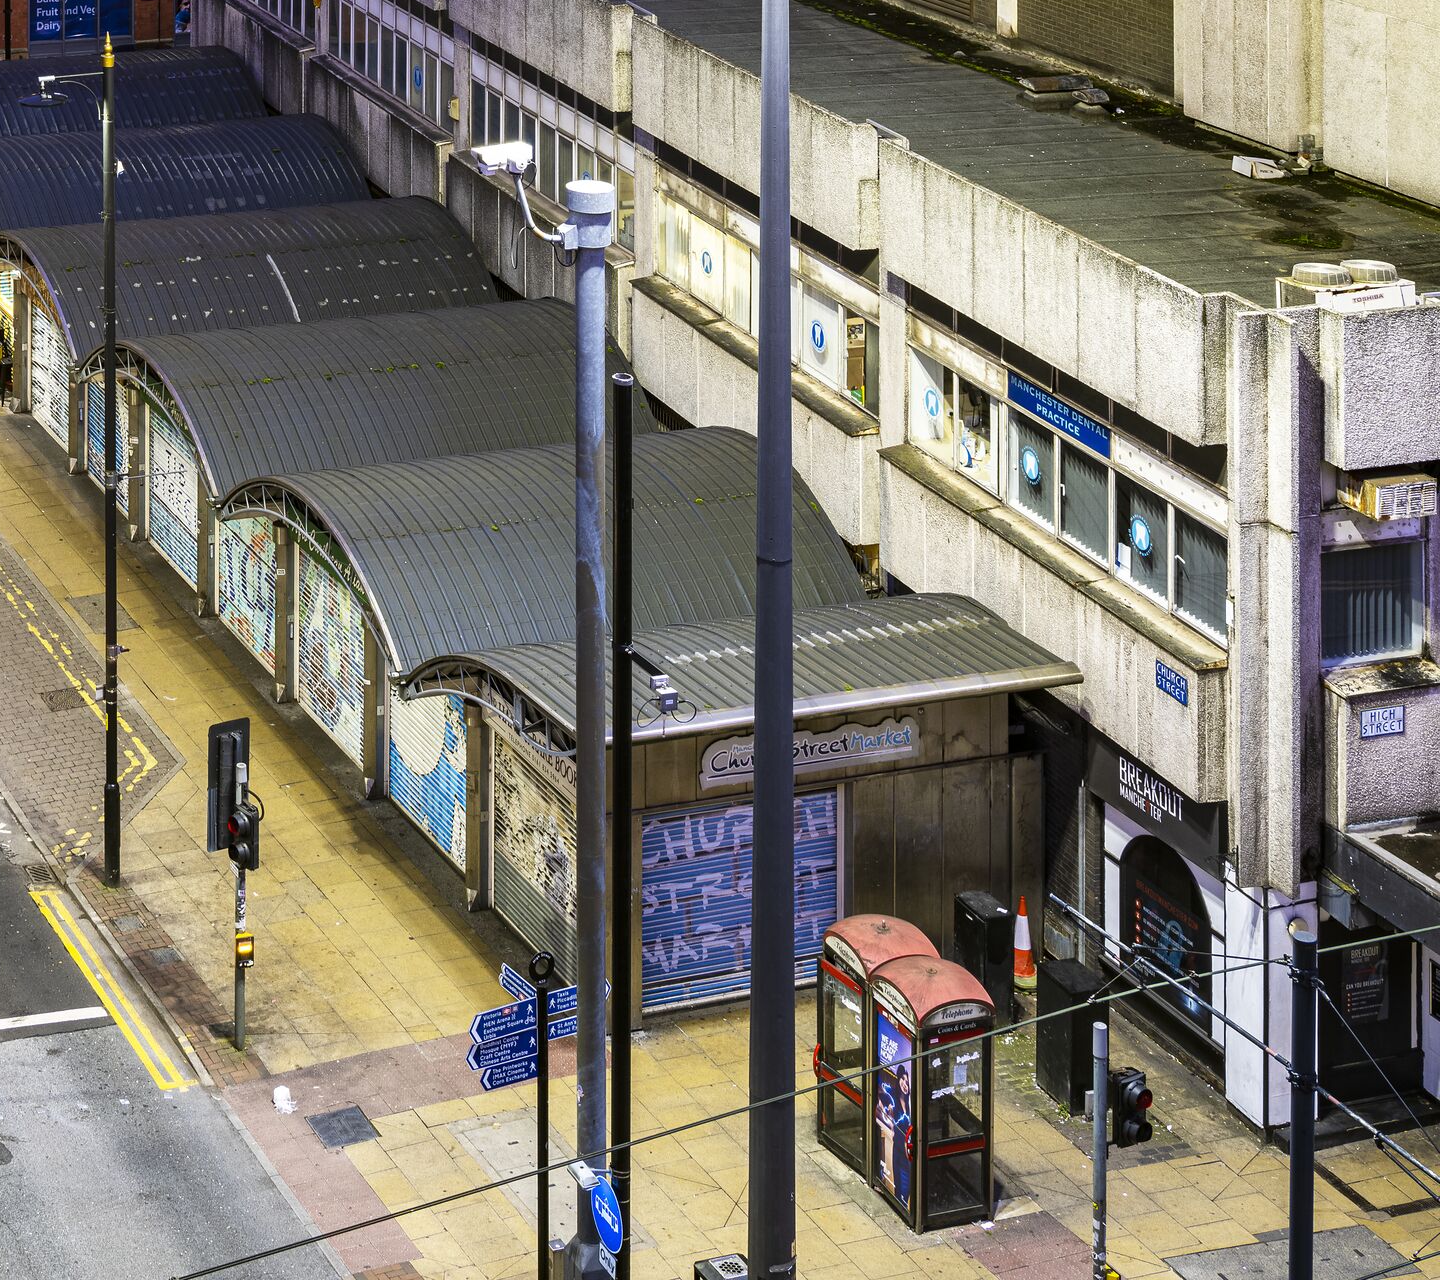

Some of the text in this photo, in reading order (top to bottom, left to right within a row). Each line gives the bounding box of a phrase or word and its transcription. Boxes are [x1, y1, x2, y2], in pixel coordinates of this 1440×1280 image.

[36, 7, 59, 17] Fruit
[63, 6, 78, 16] nd
[36, 21, 61, 32] Dairy
[1352, 293, 1384, 303] TOSHIBA
[1010, 375, 1108, 440] MANCHESTER DENTAL
[1036, 403, 1080, 437] PRACTICE
[1156, 663, 1186, 690] CHURCH
[1157, 675, 1185, 702] STREET
[1370, 709, 1396, 722] HIGH
[1362, 720, 1402, 735] STREET
[711, 726, 911, 773] Chu Street Market
[1119, 756, 1184, 822] BREAKOUT
[642, 794, 837, 869] CHURH
[1350, 946, 1379, 959] BREAKOUT
[483, 1011, 501, 1020] Victoria
[941, 1008, 973, 1020] Telephone
[483, 1020, 495, 1028] MEN
[483, 1020, 523, 1034] Exchange Square
[937, 1026, 953, 1034] Coins
[960, 1021, 977, 1030] Cards
[557, 1027, 569, 1035] Royal
[503, 1035, 519, 1043] Centre
[480, 1047, 499, 1055] Mosque
[494, 1049, 511, 1057] Centre
[480, 1057, 499, 1066] Chinese
[512, 1050, 528, 1058] Centre
[502, 1061, 528, 1071] Printworks
[507, 1067, 525, 1076] Cinema
[506, 1072, 529, 1082] Exchange
[600, 1248, 615, 1274] Only
